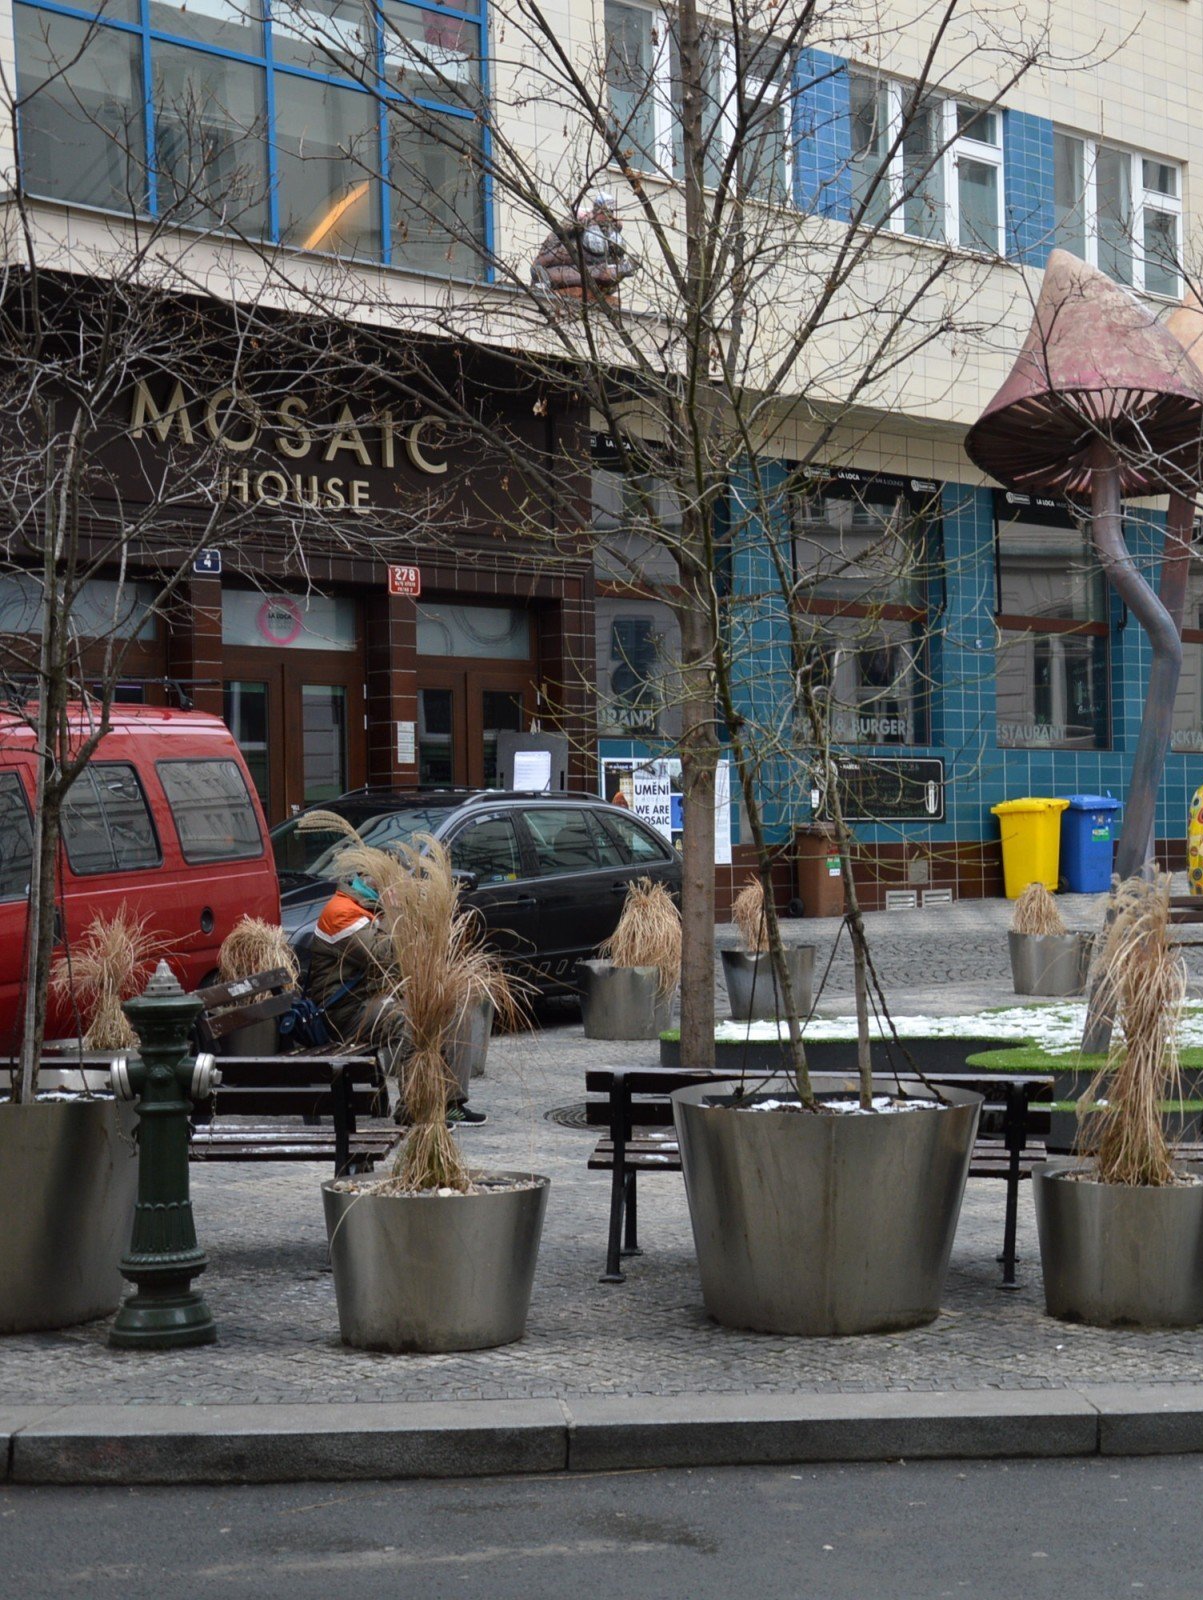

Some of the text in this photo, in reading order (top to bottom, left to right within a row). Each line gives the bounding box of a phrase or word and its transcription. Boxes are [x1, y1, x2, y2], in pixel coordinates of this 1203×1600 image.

[131, 379, 448, 475] MOSAIC
[838, 471, 845, 479] LA
[846, 472, 860, 481] LOCA
[221, 467, 370, 514] HOUSE
[203, 553, 212, 568] 4
[394, 568, 416, 581] 278
[850, 718, 914, 736] BURGERS
[996, 724, 1066, 741] ESTAURANT
[634, 781, 670, 796] UMĚNÍ
[635, 804, 670, 814] WE ARE
[643, 816, 670, 826] OSAIC
